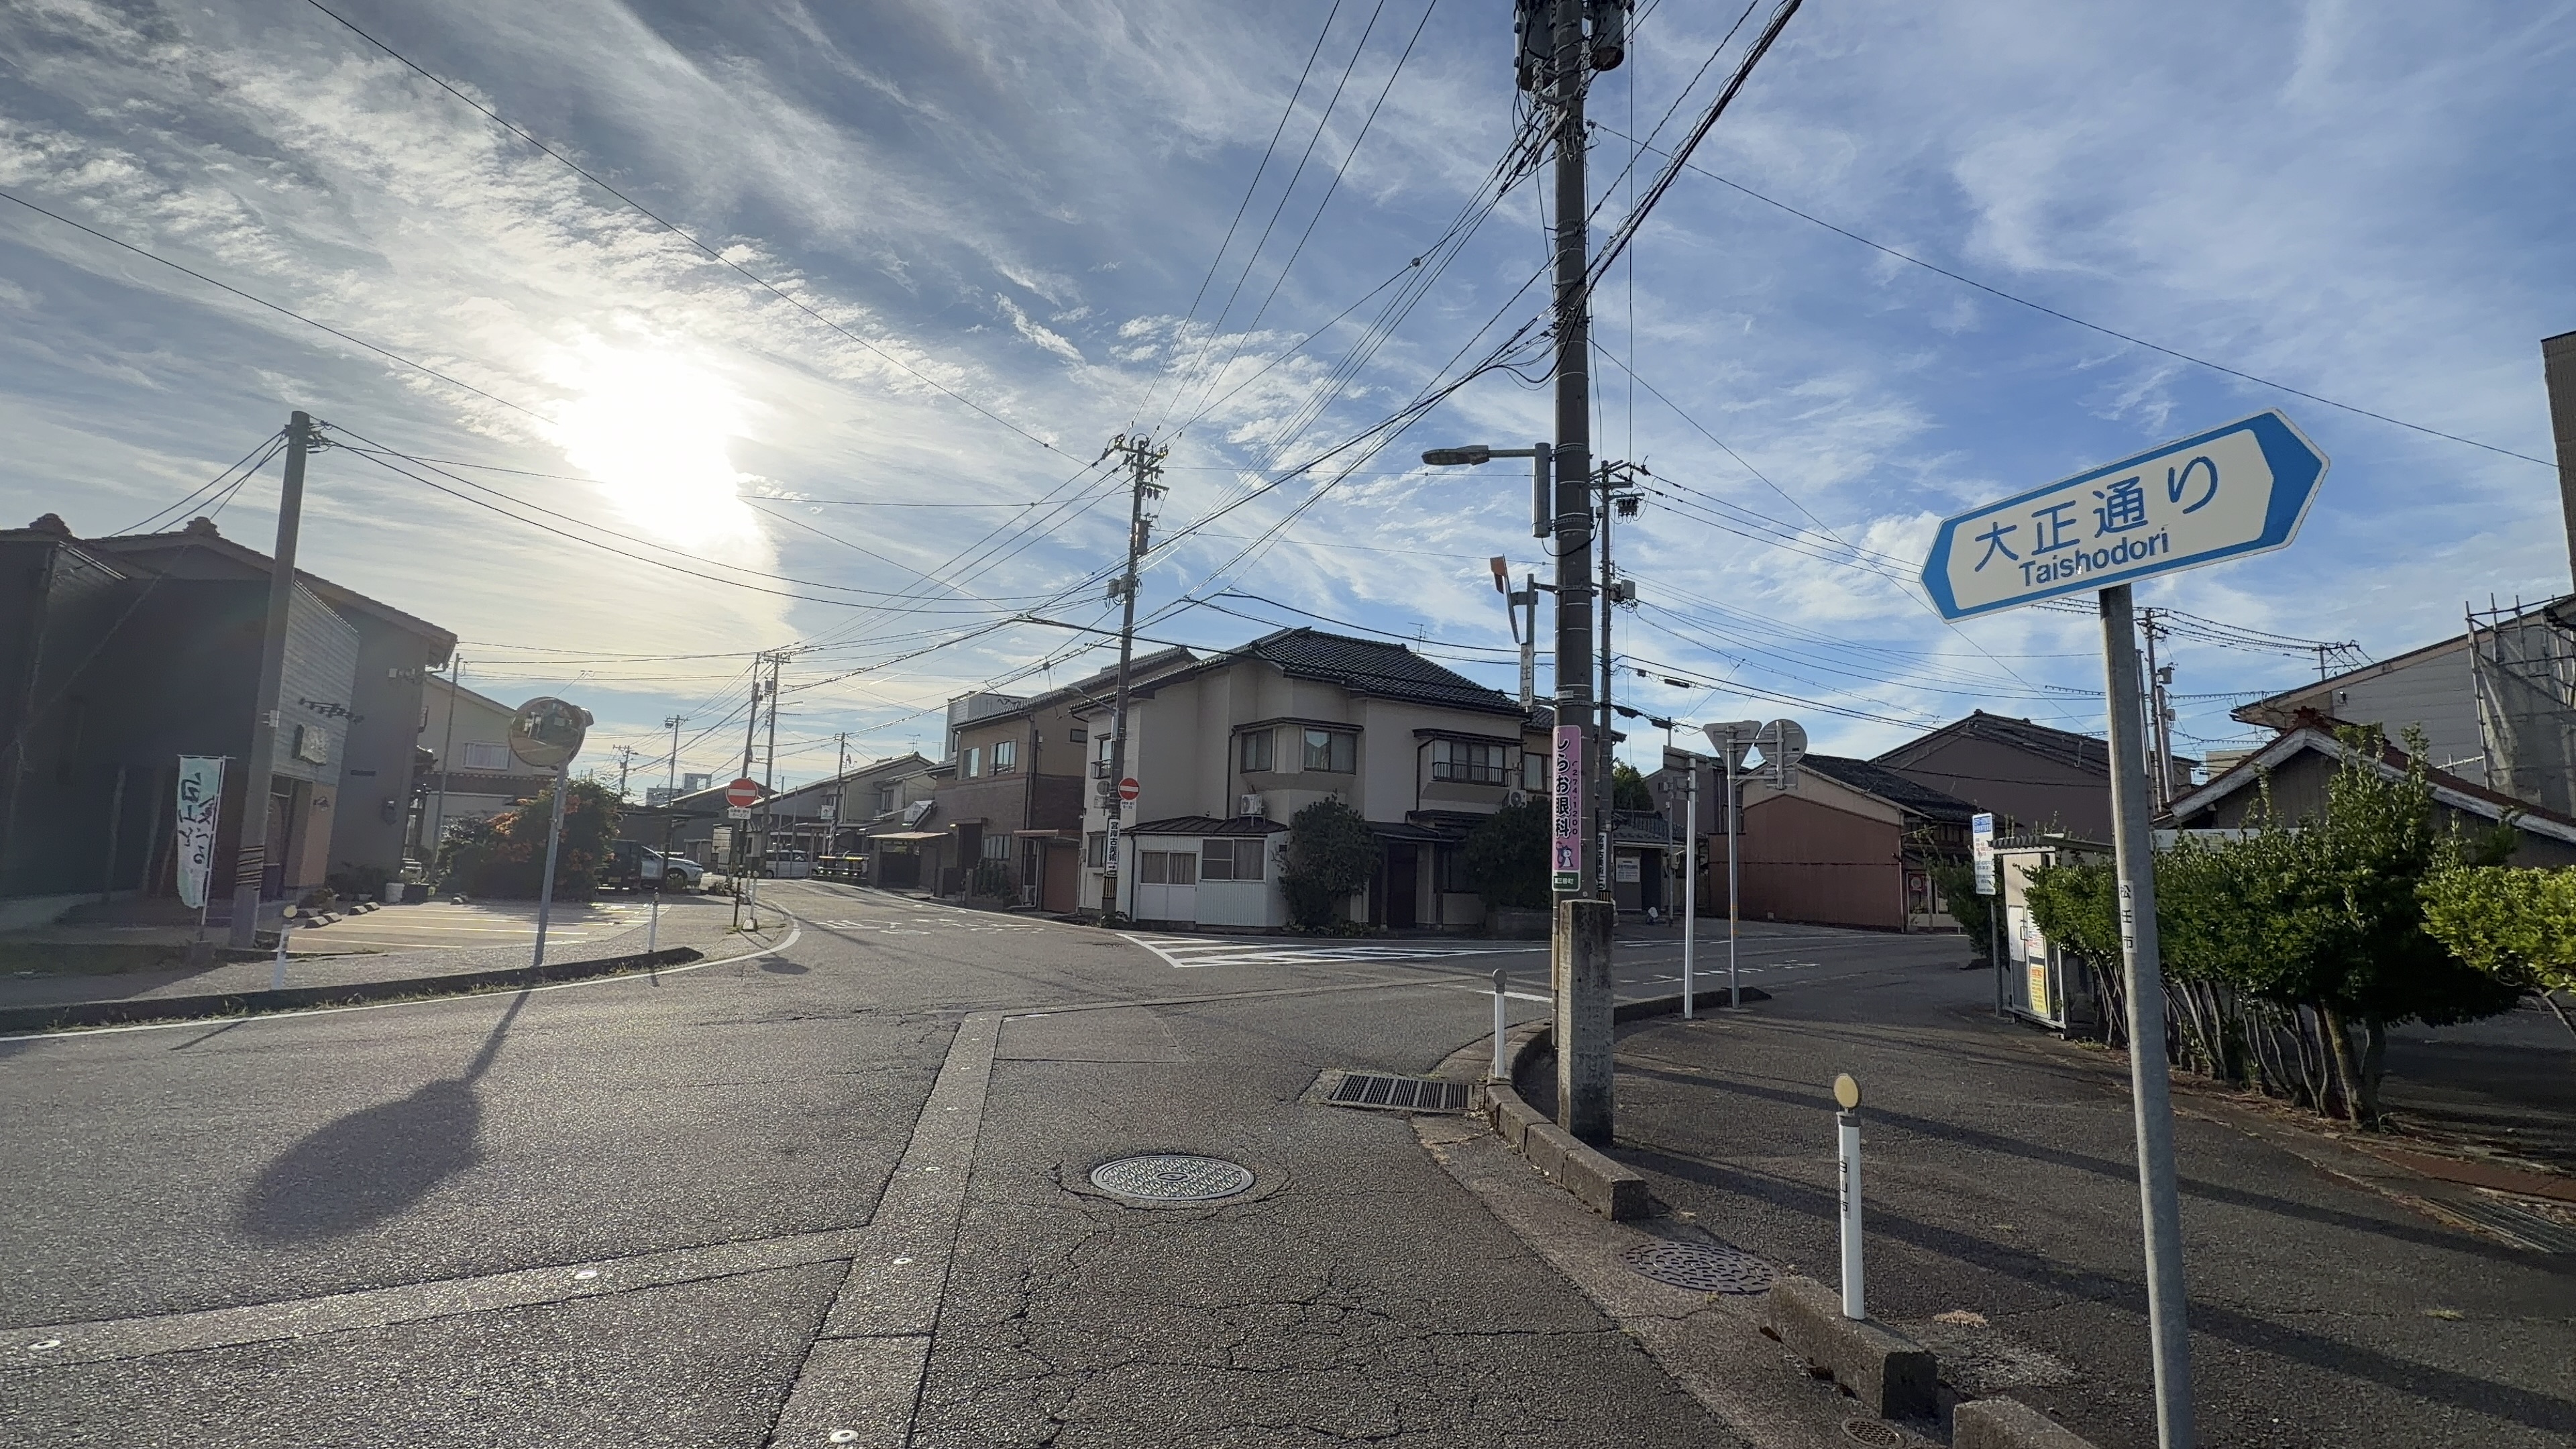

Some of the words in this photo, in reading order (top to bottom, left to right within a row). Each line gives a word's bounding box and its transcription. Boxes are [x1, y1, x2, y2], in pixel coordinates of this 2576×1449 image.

[1975, 456, 2218, 572] 大正通り
[2019, 526, 2169, 587] Taishodori
[1521, 665, 1532, 702] 注意
[1555, 731, 1572, 838] しらお眼科
[2121, 885, 2134, 949] 松任市
